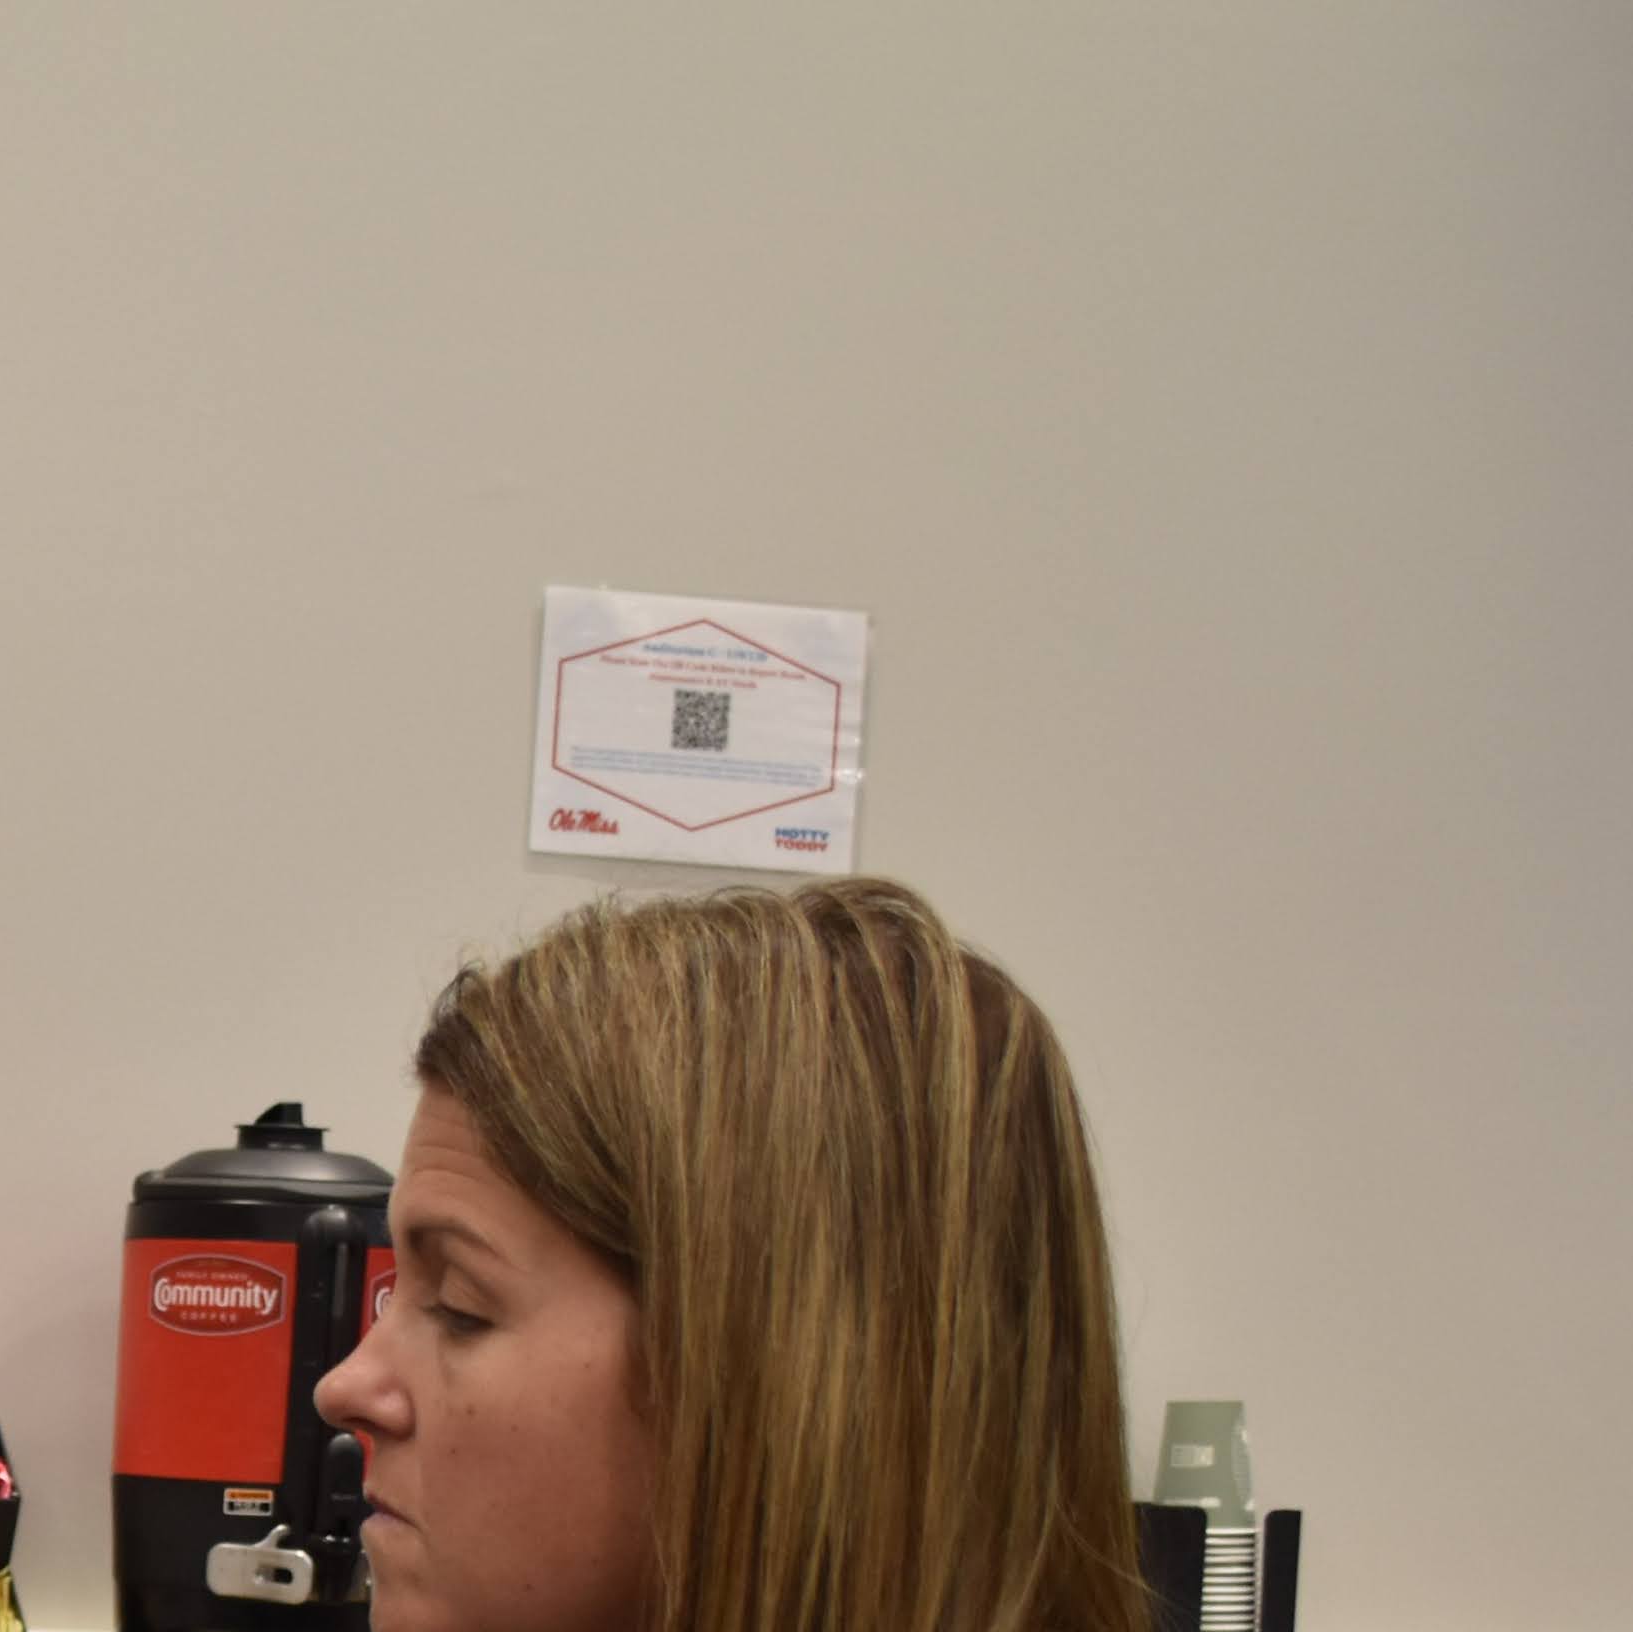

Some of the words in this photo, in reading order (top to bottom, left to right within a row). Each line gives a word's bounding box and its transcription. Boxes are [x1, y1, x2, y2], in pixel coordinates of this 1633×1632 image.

[548, 808, 575, 832] Ole
[575, 810, 621, 834] Miss
[774, 827, 830, 841] HOTTY
[774, 838, 829, 851] TODDY
[153, 1277, 279, 1316] Community
[181, 1312, 239, 1323] COFFEE
